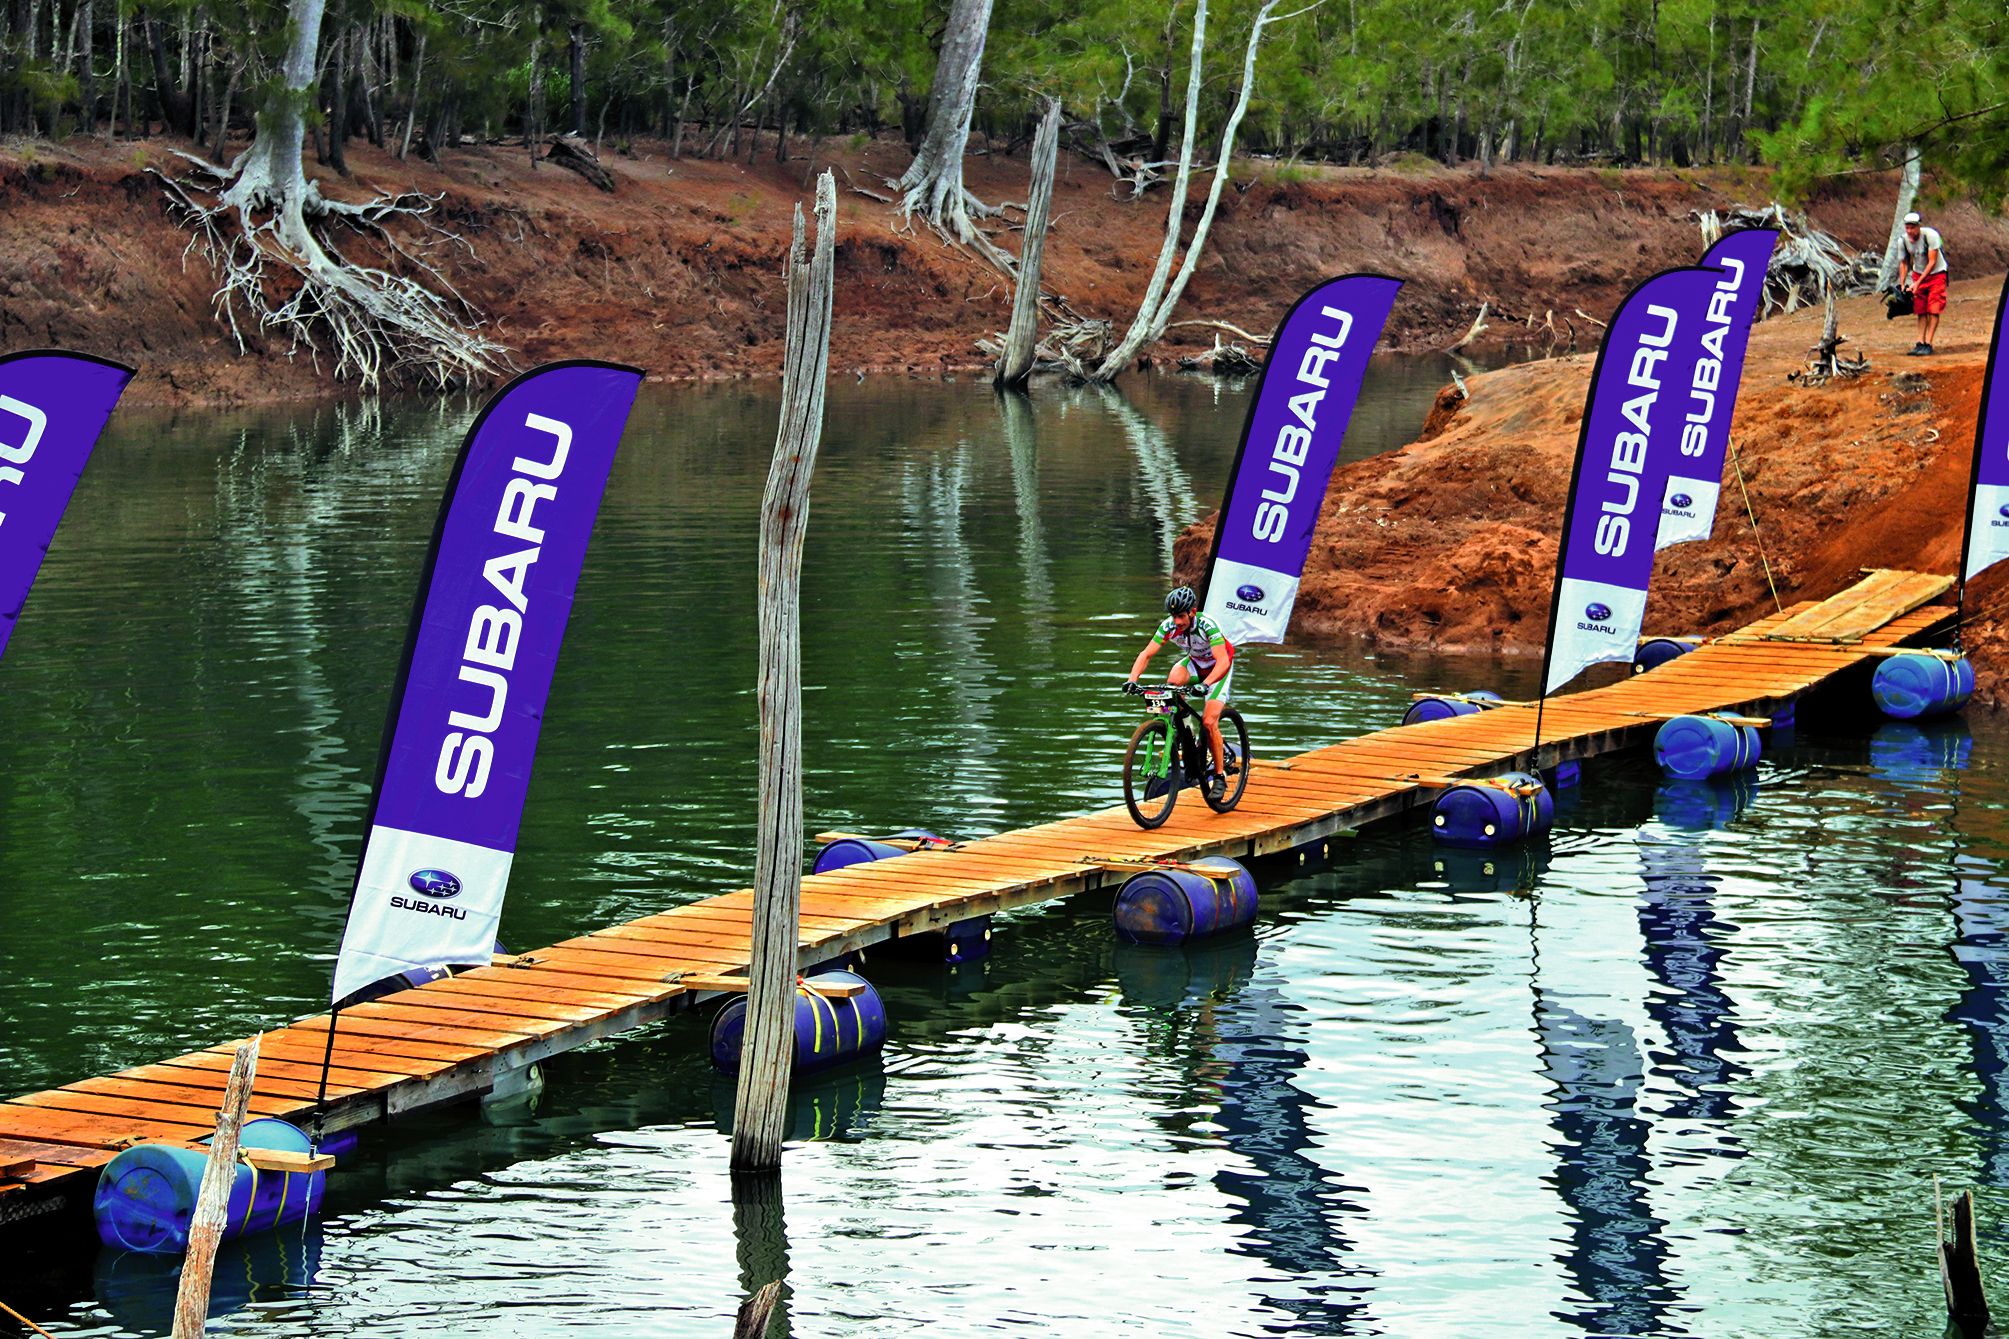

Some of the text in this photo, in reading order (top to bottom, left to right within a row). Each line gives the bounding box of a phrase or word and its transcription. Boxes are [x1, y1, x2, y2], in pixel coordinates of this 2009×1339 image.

[1681, 257, 1745, 458] SUBARU
[1252, 305, 1354, 543] SUBARU
[1594, 304, 1678, 557] SUBARU
[1662, 508, 1696, 518] SUBARU
[434, 412, 573, 799] SUBARU
[1226, 601, 1268, 616] SUBARU
[1577, 622, 1616, 635] SUBARU
[390, 896, 467, 921] SUBARU
